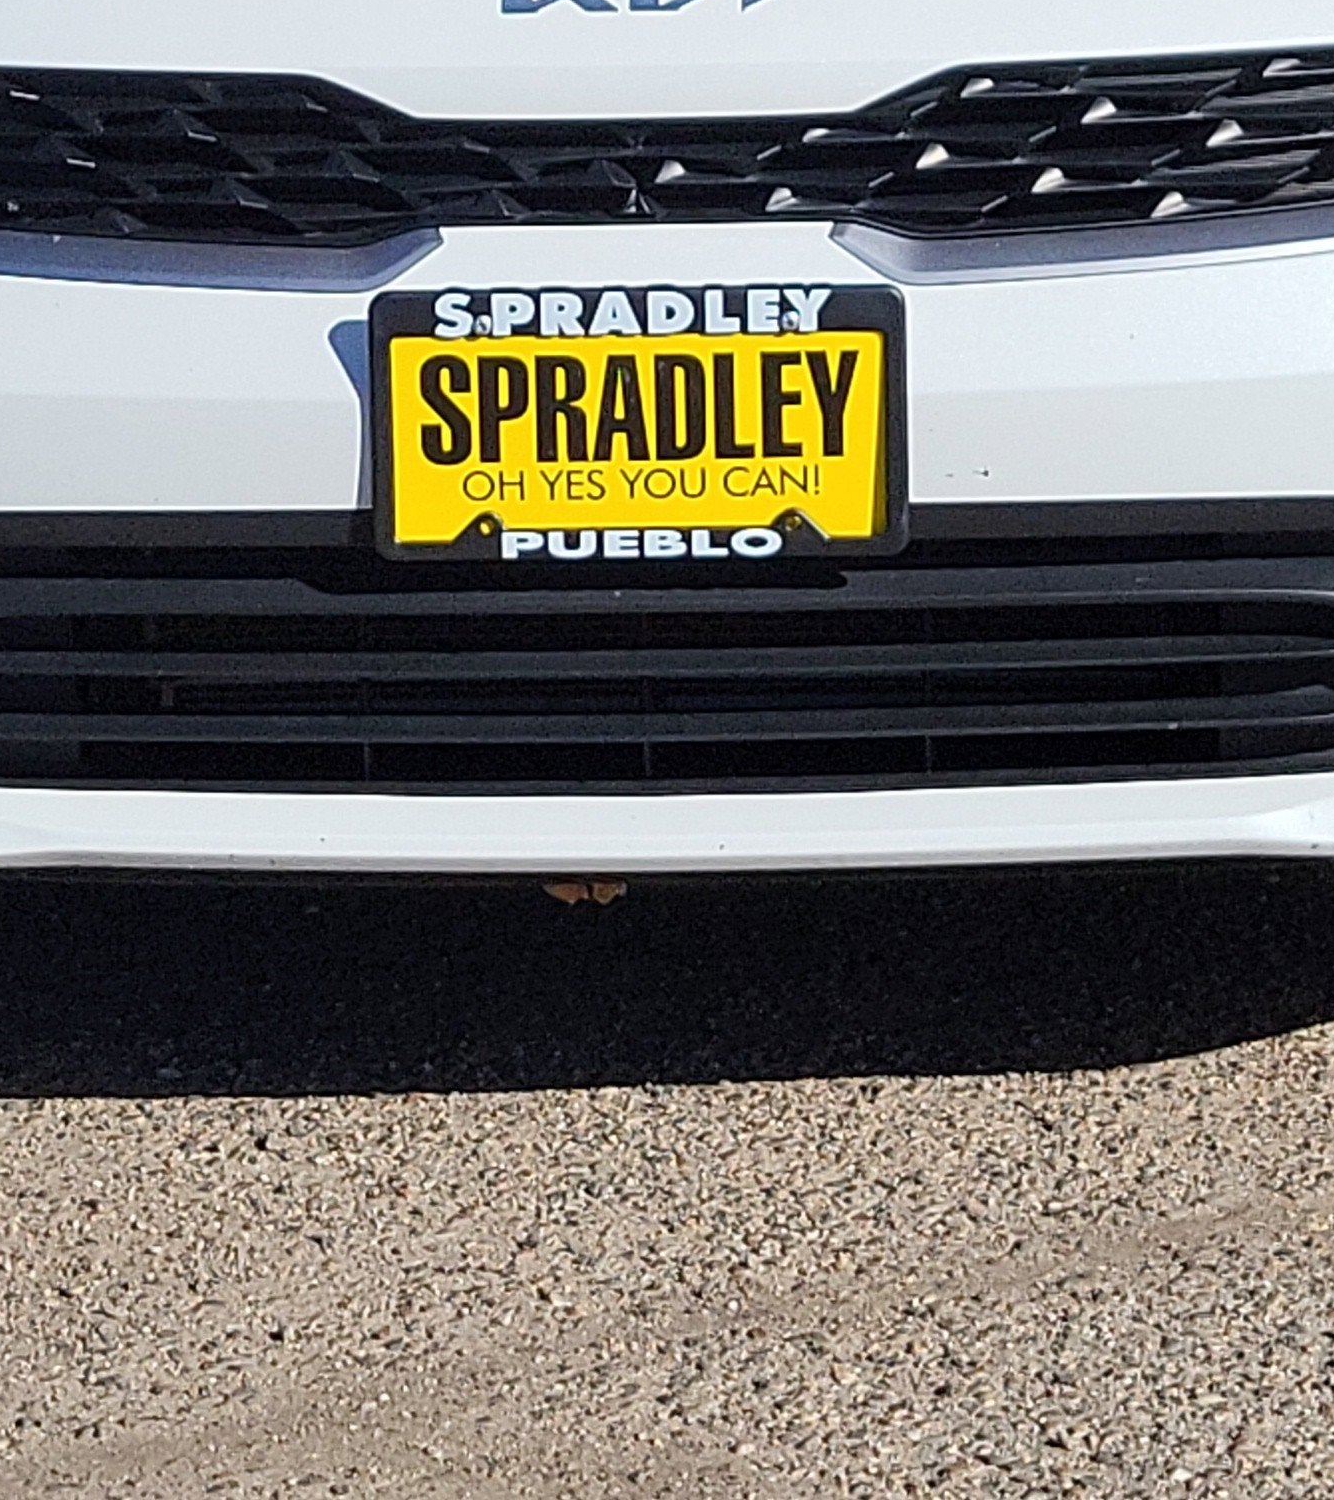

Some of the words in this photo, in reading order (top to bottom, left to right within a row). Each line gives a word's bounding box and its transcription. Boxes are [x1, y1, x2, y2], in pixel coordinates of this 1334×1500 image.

[419, 349, 859, 465] SPRADLEY
[462, 470, 525, 501] OH
[540, 469, 606, 501] YES
[620, 467, 706, 499] YOU
[722, 464, 820, 498] CAN!
[501, 528, 783, 559] PUEBLO
